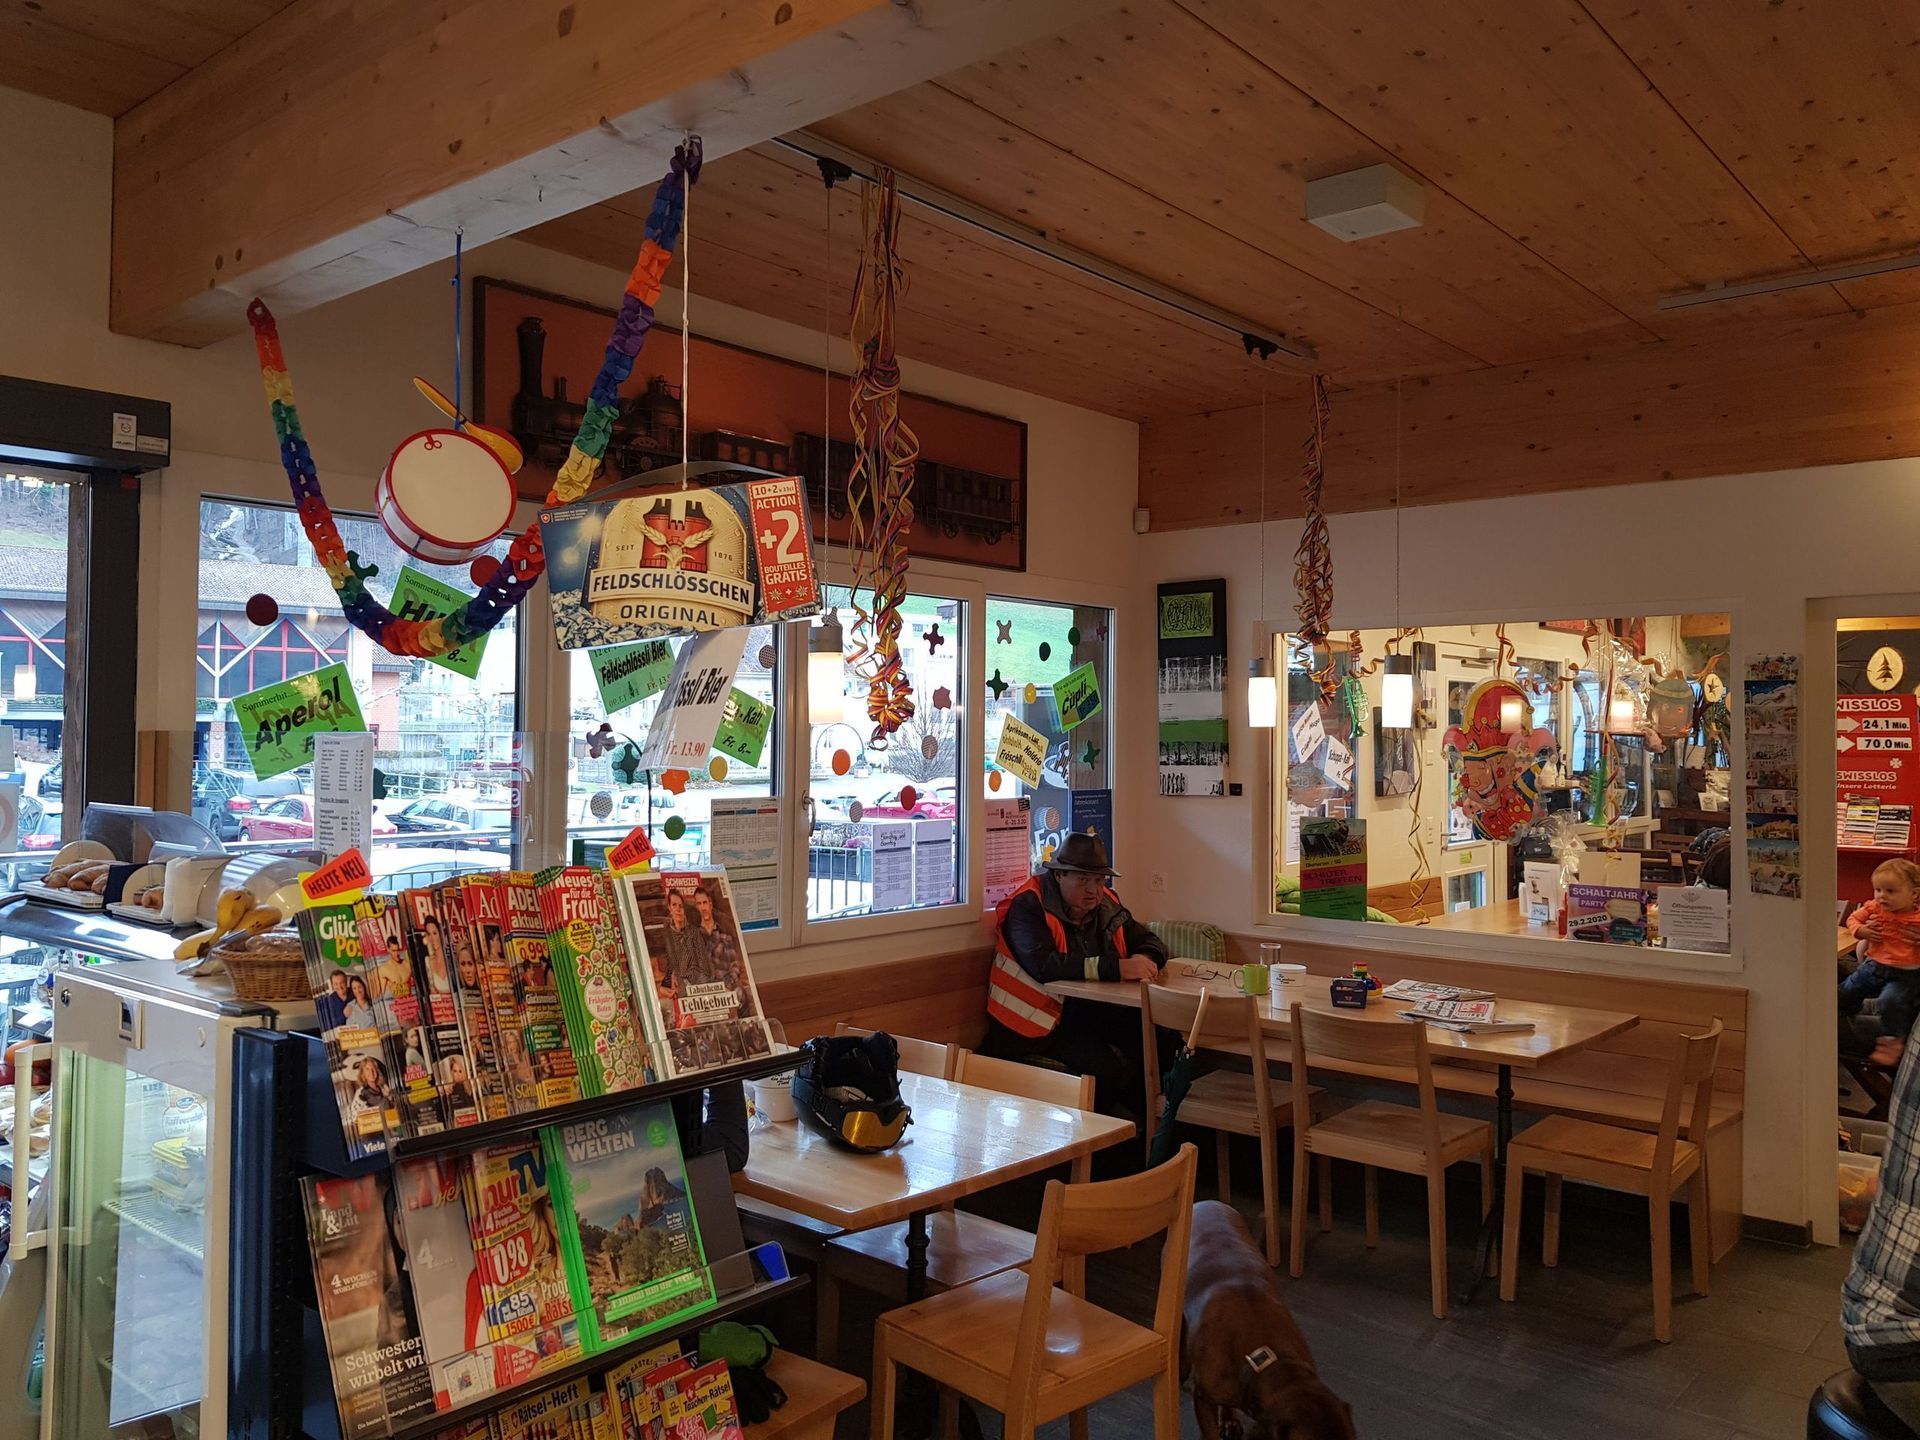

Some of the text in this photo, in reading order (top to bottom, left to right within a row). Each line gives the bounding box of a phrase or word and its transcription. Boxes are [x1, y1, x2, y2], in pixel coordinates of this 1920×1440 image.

[756, 495, 797, 510] ACTION
[615, 544, 634, 552] SEIT
[760, 510, 804, 565] +2
[764, 561, 806, 574] BOUTEILLES
[766, 570, 808, 585] GRATIS
[593, 571, 750, 606] FELDSCHLÖSSCHEN
[620, 604, 721, 627] ORIGINAL
[696, 667, 729, 705] Bier
[1062, 678, 1088, 716] Cüpli
[255, 676, 341, 752] Aperol
[681, 741, 705, 757] 13.90
[1023, 745, 1042, 767] Holdrio
[612, 832, 650, 867] HEUTE NEU
[308, 856, 366, 896] HEUTE NEU
[554, 874, 593, 888] Neues
[569, 888, 592, 899] für die
[1572, 887, 1638, 900] SCHALTJAHR
[1580, 899, 1604, 907] PARTY
[561, 893, 600, 921] Frau
[319, 914, 358, 940] Glüc
[511, 913, 543, 930] aktuel
[1568, 914, 1608, 928] 29.2.2020
[688, 984, 724, 995] Tabuthema
[681, 993, 737, 1012] Fehlgeburt
[563, 1117, 608, 1146] BERG
[567, 1130, 635, 1163] WELTEN
[509, 1151, 547, 1195] TV
[331, 1274, 342, 1288] 4
[540, 1277, 570, 1301] Progr
[510, 1293, 530, 1310] 85
[545, 1296, 574, 1322] Rätse
[345, 1337, 422, 1373] Schwester
[349, 1350, 424, 1390] wirbelt wi
[518, 1383, 579, 1423] Rätsel-Heft
